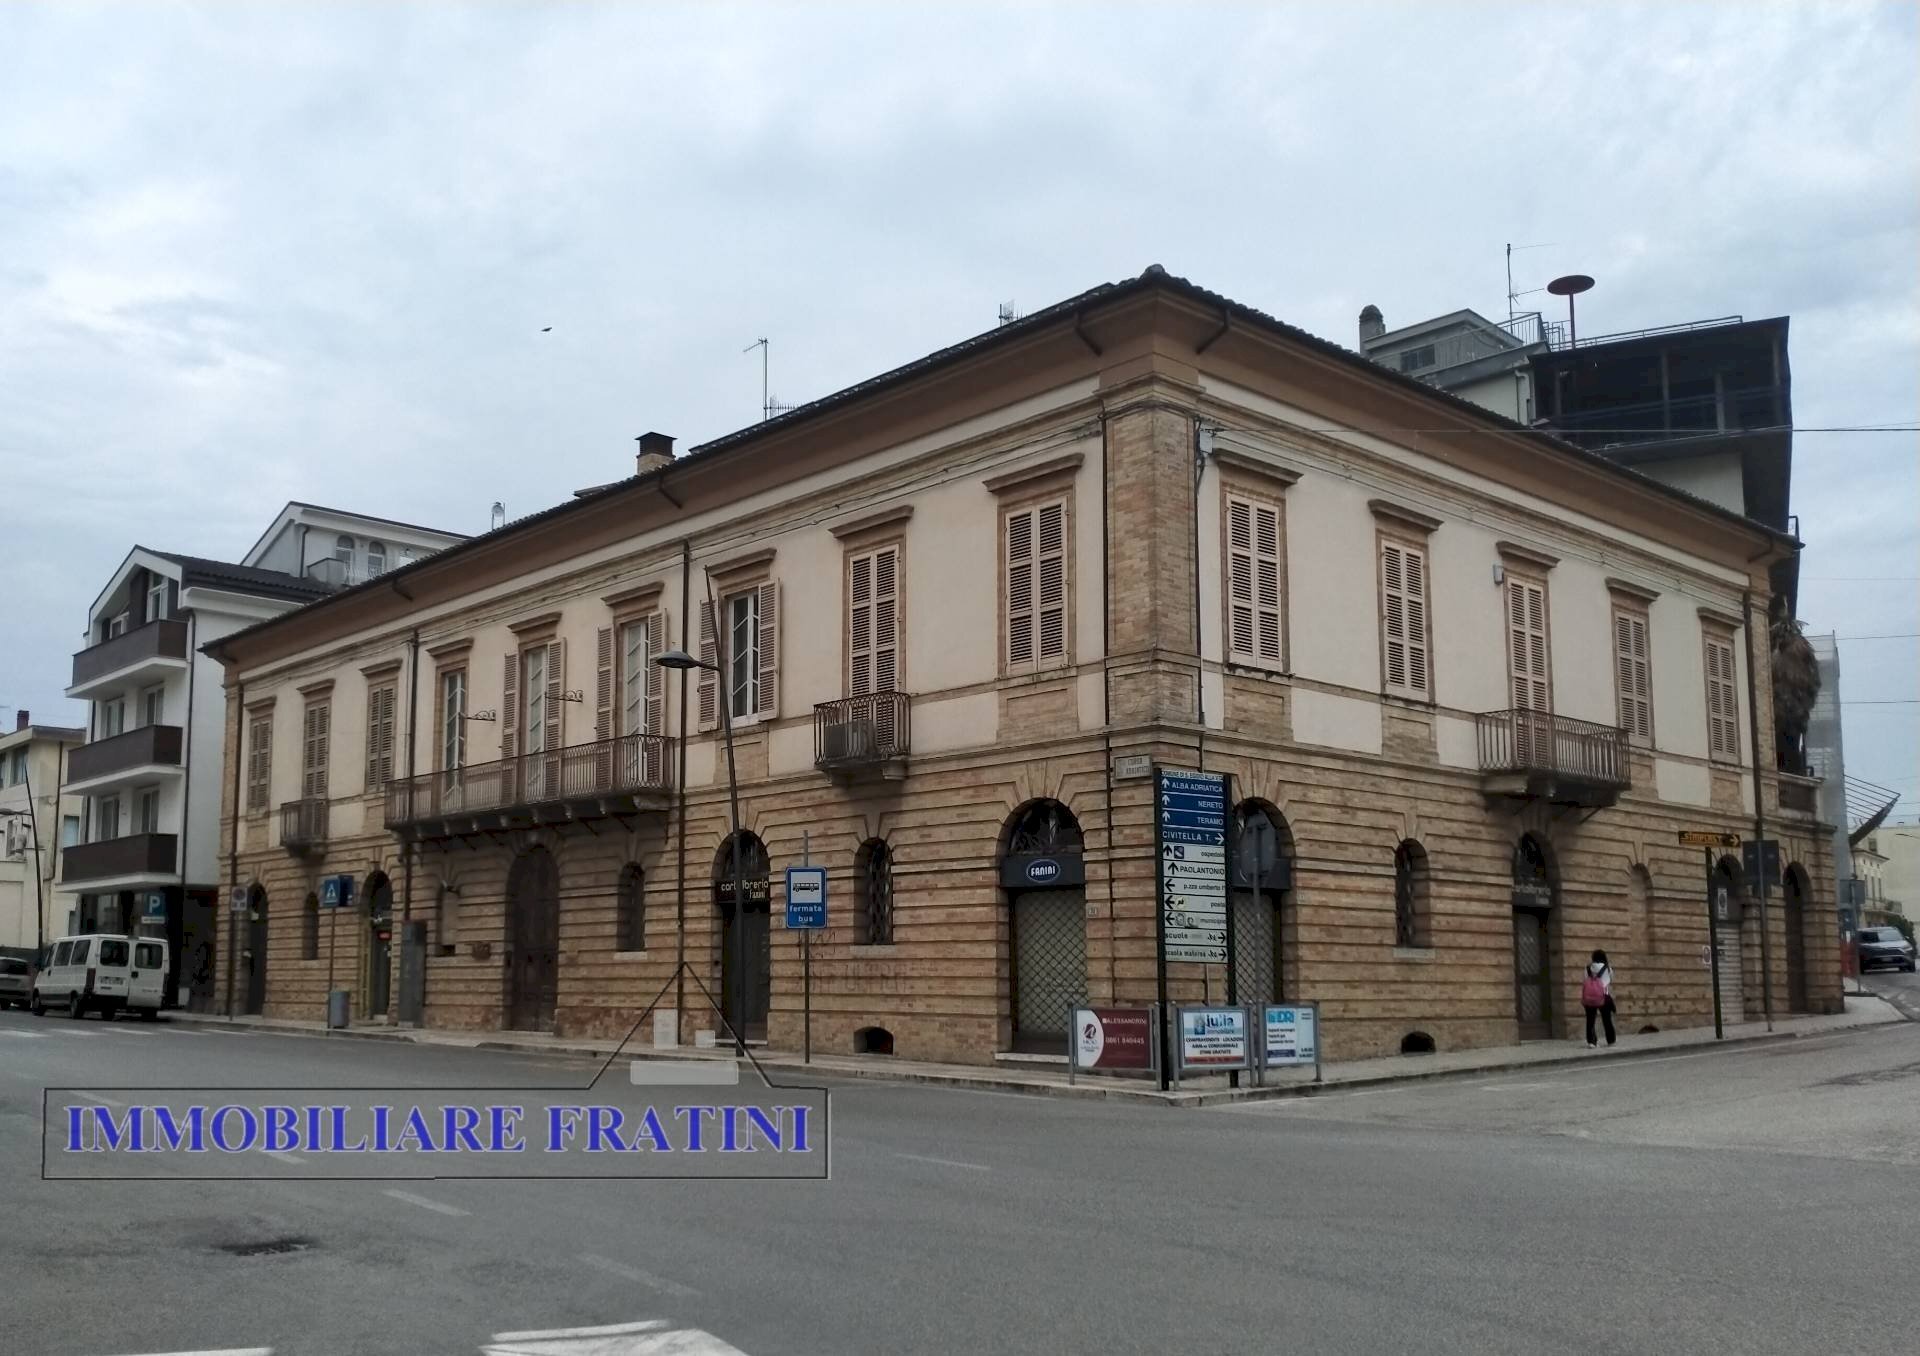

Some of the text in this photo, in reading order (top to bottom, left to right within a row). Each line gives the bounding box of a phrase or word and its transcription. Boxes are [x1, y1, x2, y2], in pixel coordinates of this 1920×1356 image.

[1172, 782, 1223, 792] ALBA ADRIATICA
[1197, 817, 1223, 825] TERAMO
[1162, 830, 1202, 841] CIVITELLA
[1031, 866, 1055, 876] FANINI
[1179, 865, 1225, 876] PAOLANTONIO
[149, 895, 161, 914] P
[789, 904, 823, 913] fermata
